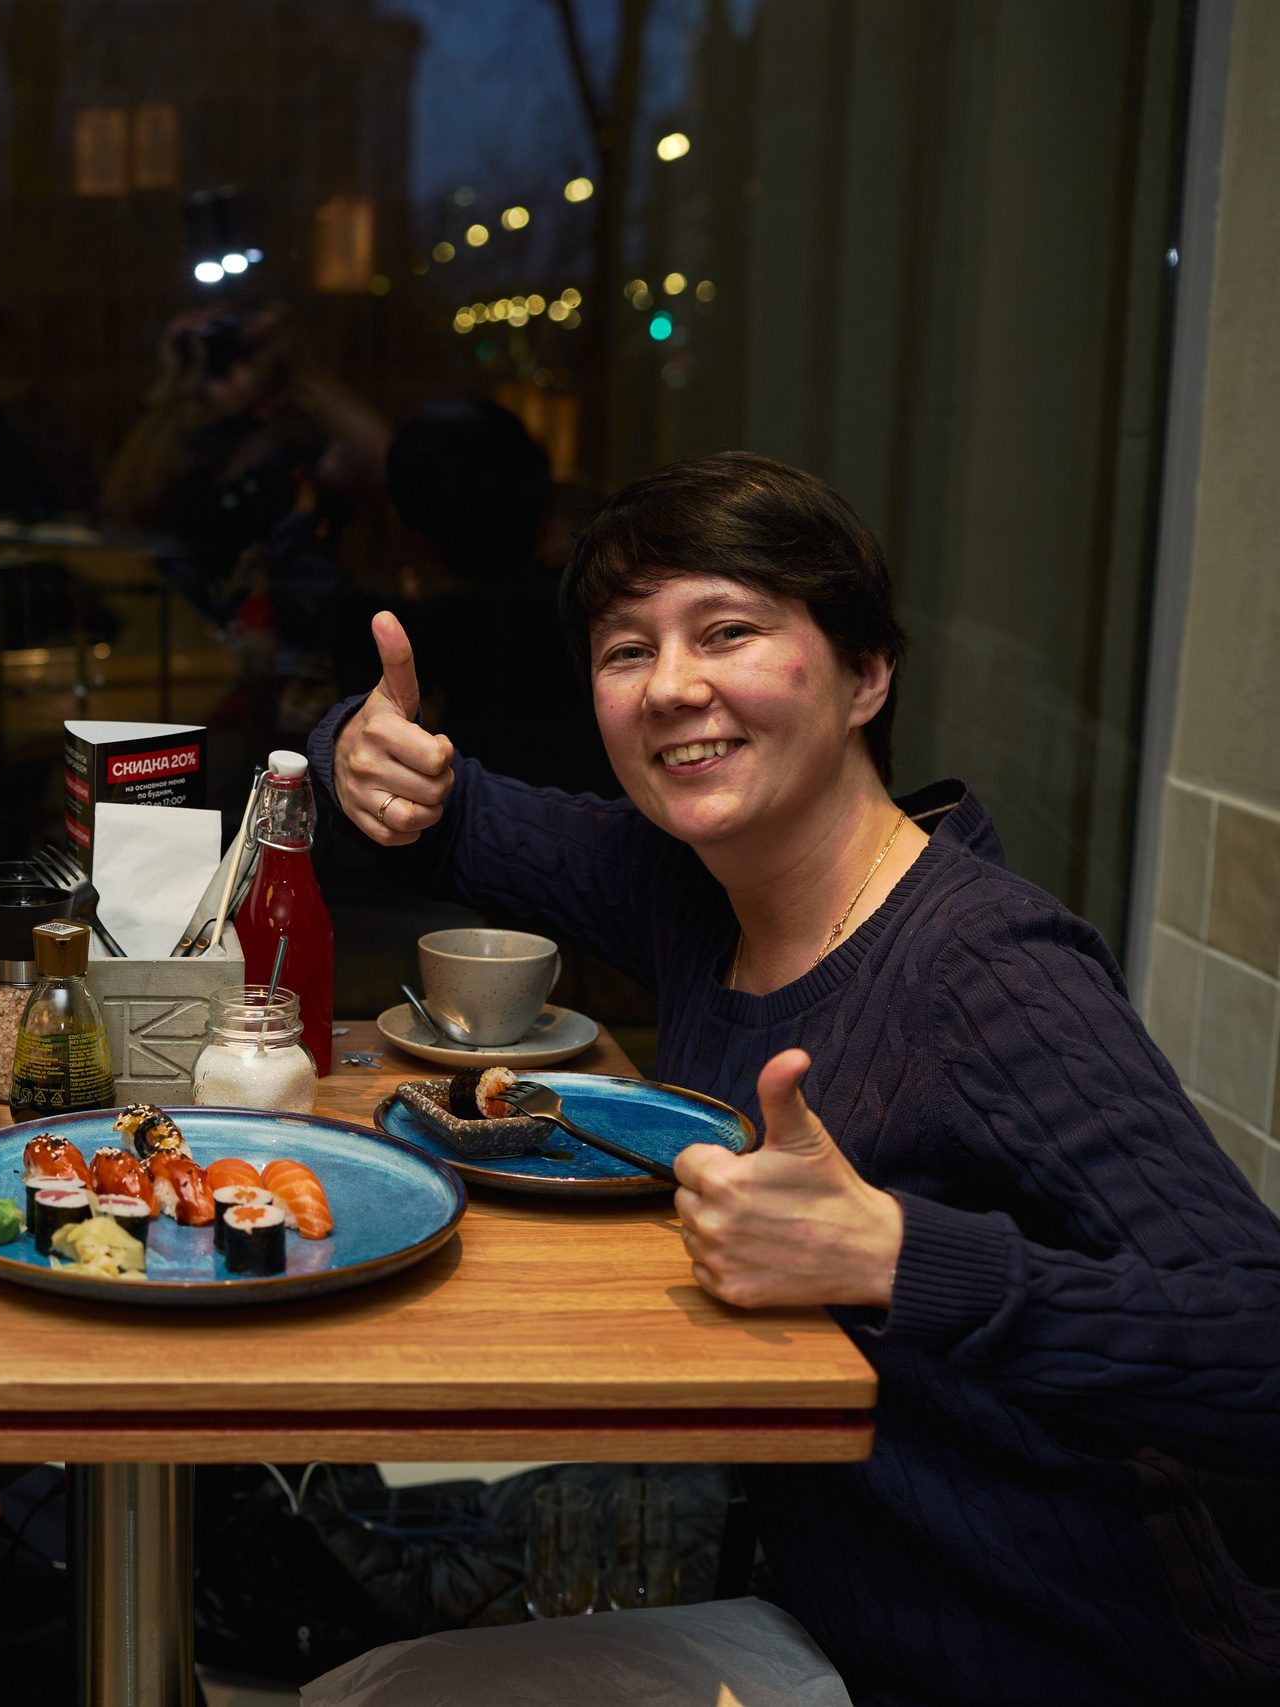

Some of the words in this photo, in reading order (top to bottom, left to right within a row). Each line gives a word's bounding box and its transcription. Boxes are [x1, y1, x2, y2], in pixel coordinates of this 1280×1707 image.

[112, 756, 170, 777] СКИДКА
[171, 751, 196, 768] 20%
[135, 781, 168, 791] основное
[168, 777, 186, 786] меню
[147, 788, 174, 800] будням,
